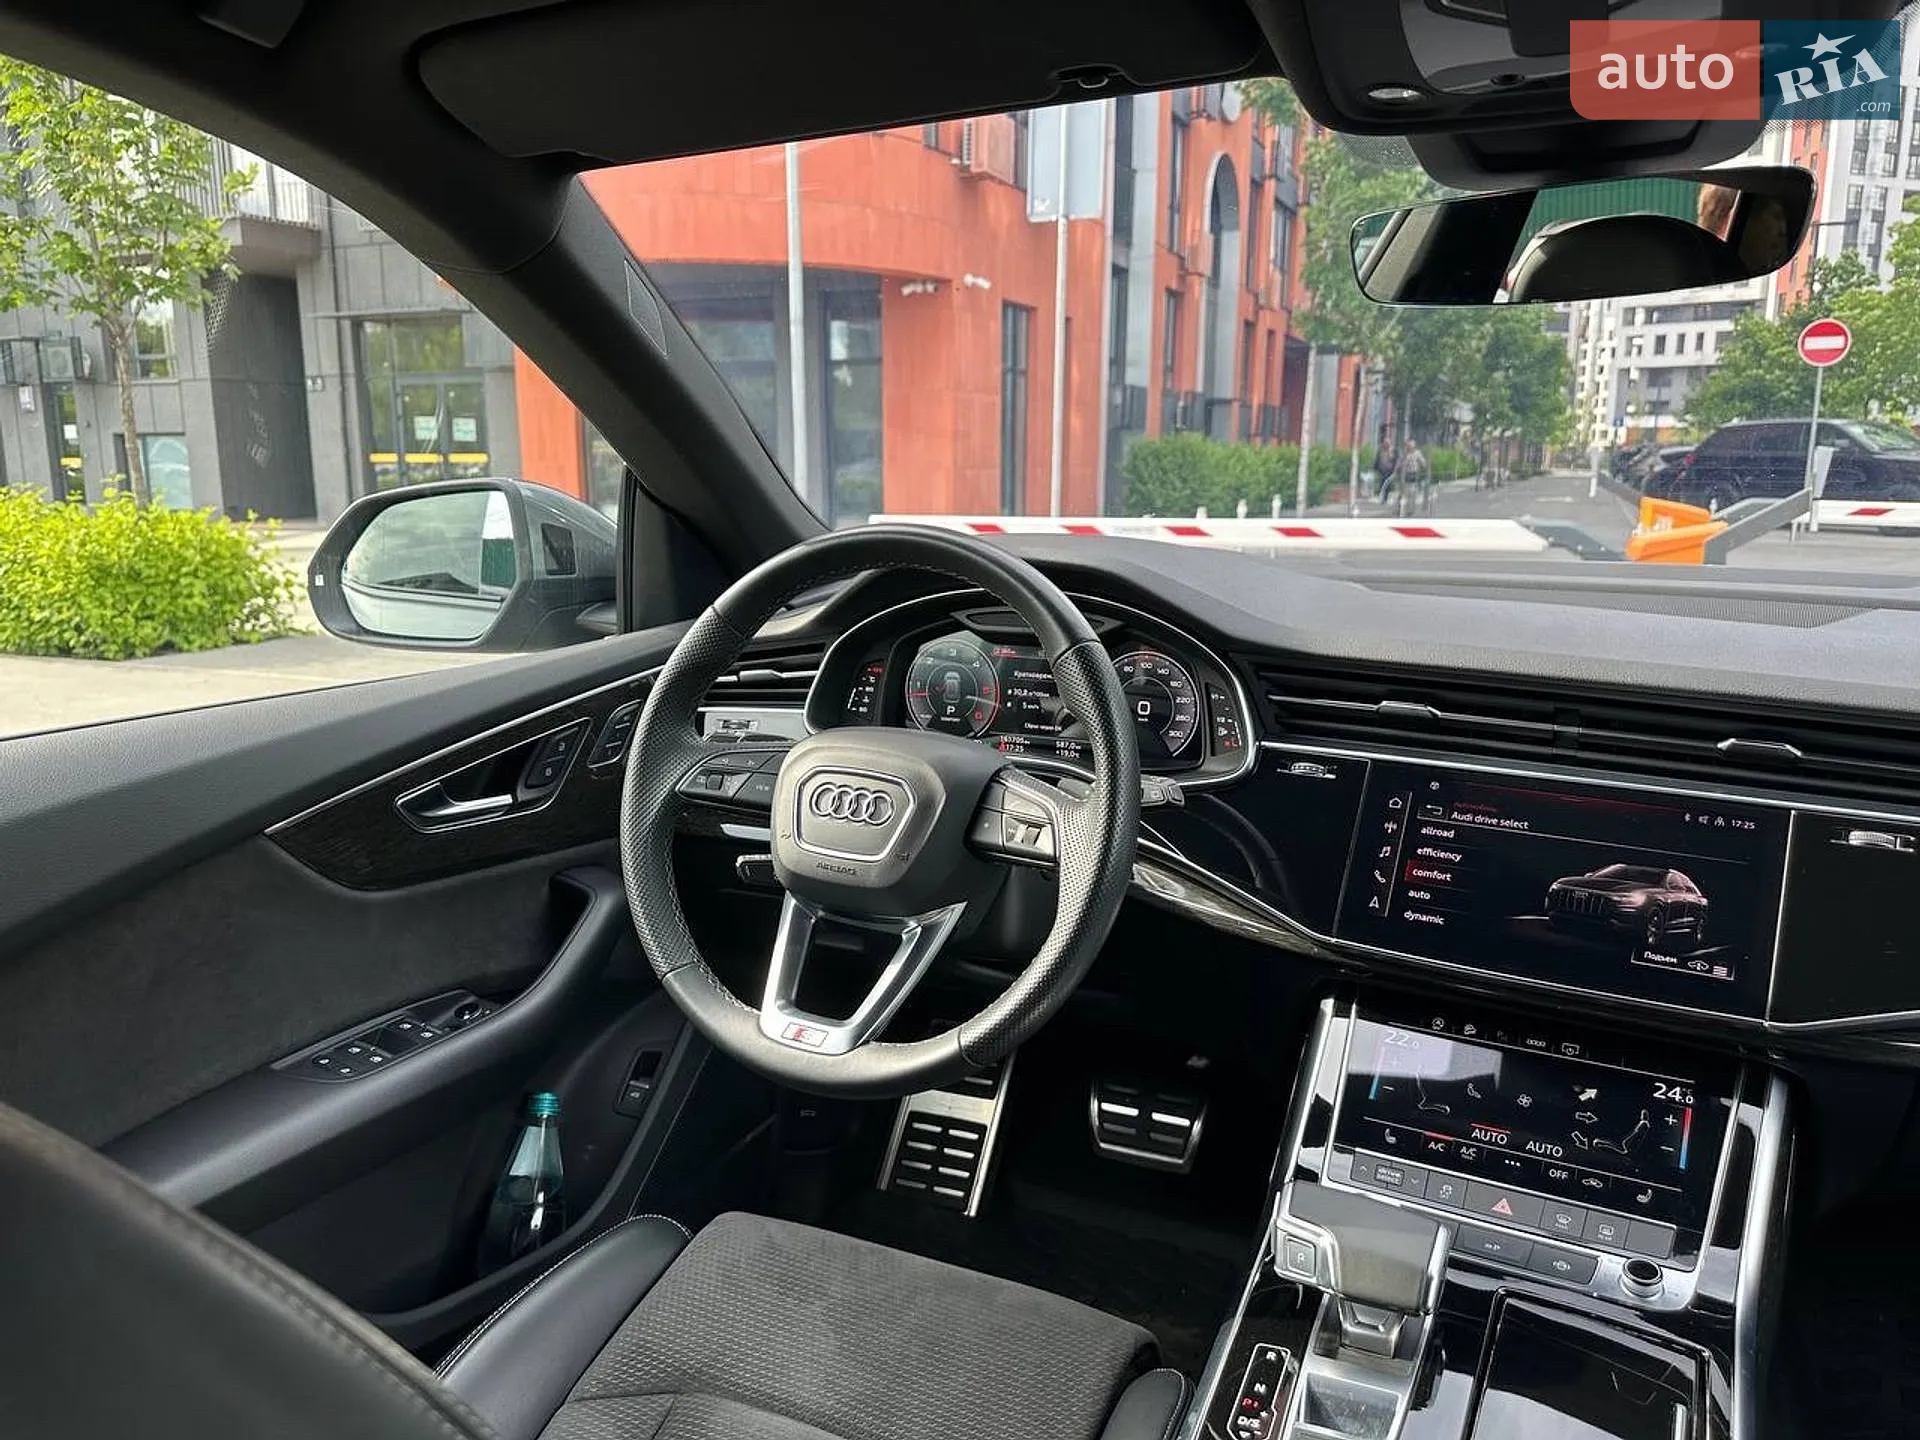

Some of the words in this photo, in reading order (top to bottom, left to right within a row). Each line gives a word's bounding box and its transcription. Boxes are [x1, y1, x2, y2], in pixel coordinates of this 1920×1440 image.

[946, 704, 956, 716] P
[1137, 700, 1151, 716] 0
[1451, 811, 1474, 822] Audi
[1475, 813, 1498, 827] drive
[1499, 817, 1530, 830] select
[1731, 819, 1756, 830] 17:25
[1420, 826, 1455, 839] allroad
[1416, 847, 1462, 863] efficiency
[1412, 868, 1453, 882] comfort
[1407, 889, 1431, 900] auto
[1403, 909, 1446, 926] dynamic
[1471, 1127, 1508, 1146] AUTO
[1427, 1140, 1447, 1153] A/C
[1525, 1139, 1564, 1159] AUTO
[1548, 1167, 1570, 1181] OFF
[1266, 1350, 1278, 1361] R
[1253, 1382, 1267, 1395] N
[1237, 1415, 1261, 1429] D/S
